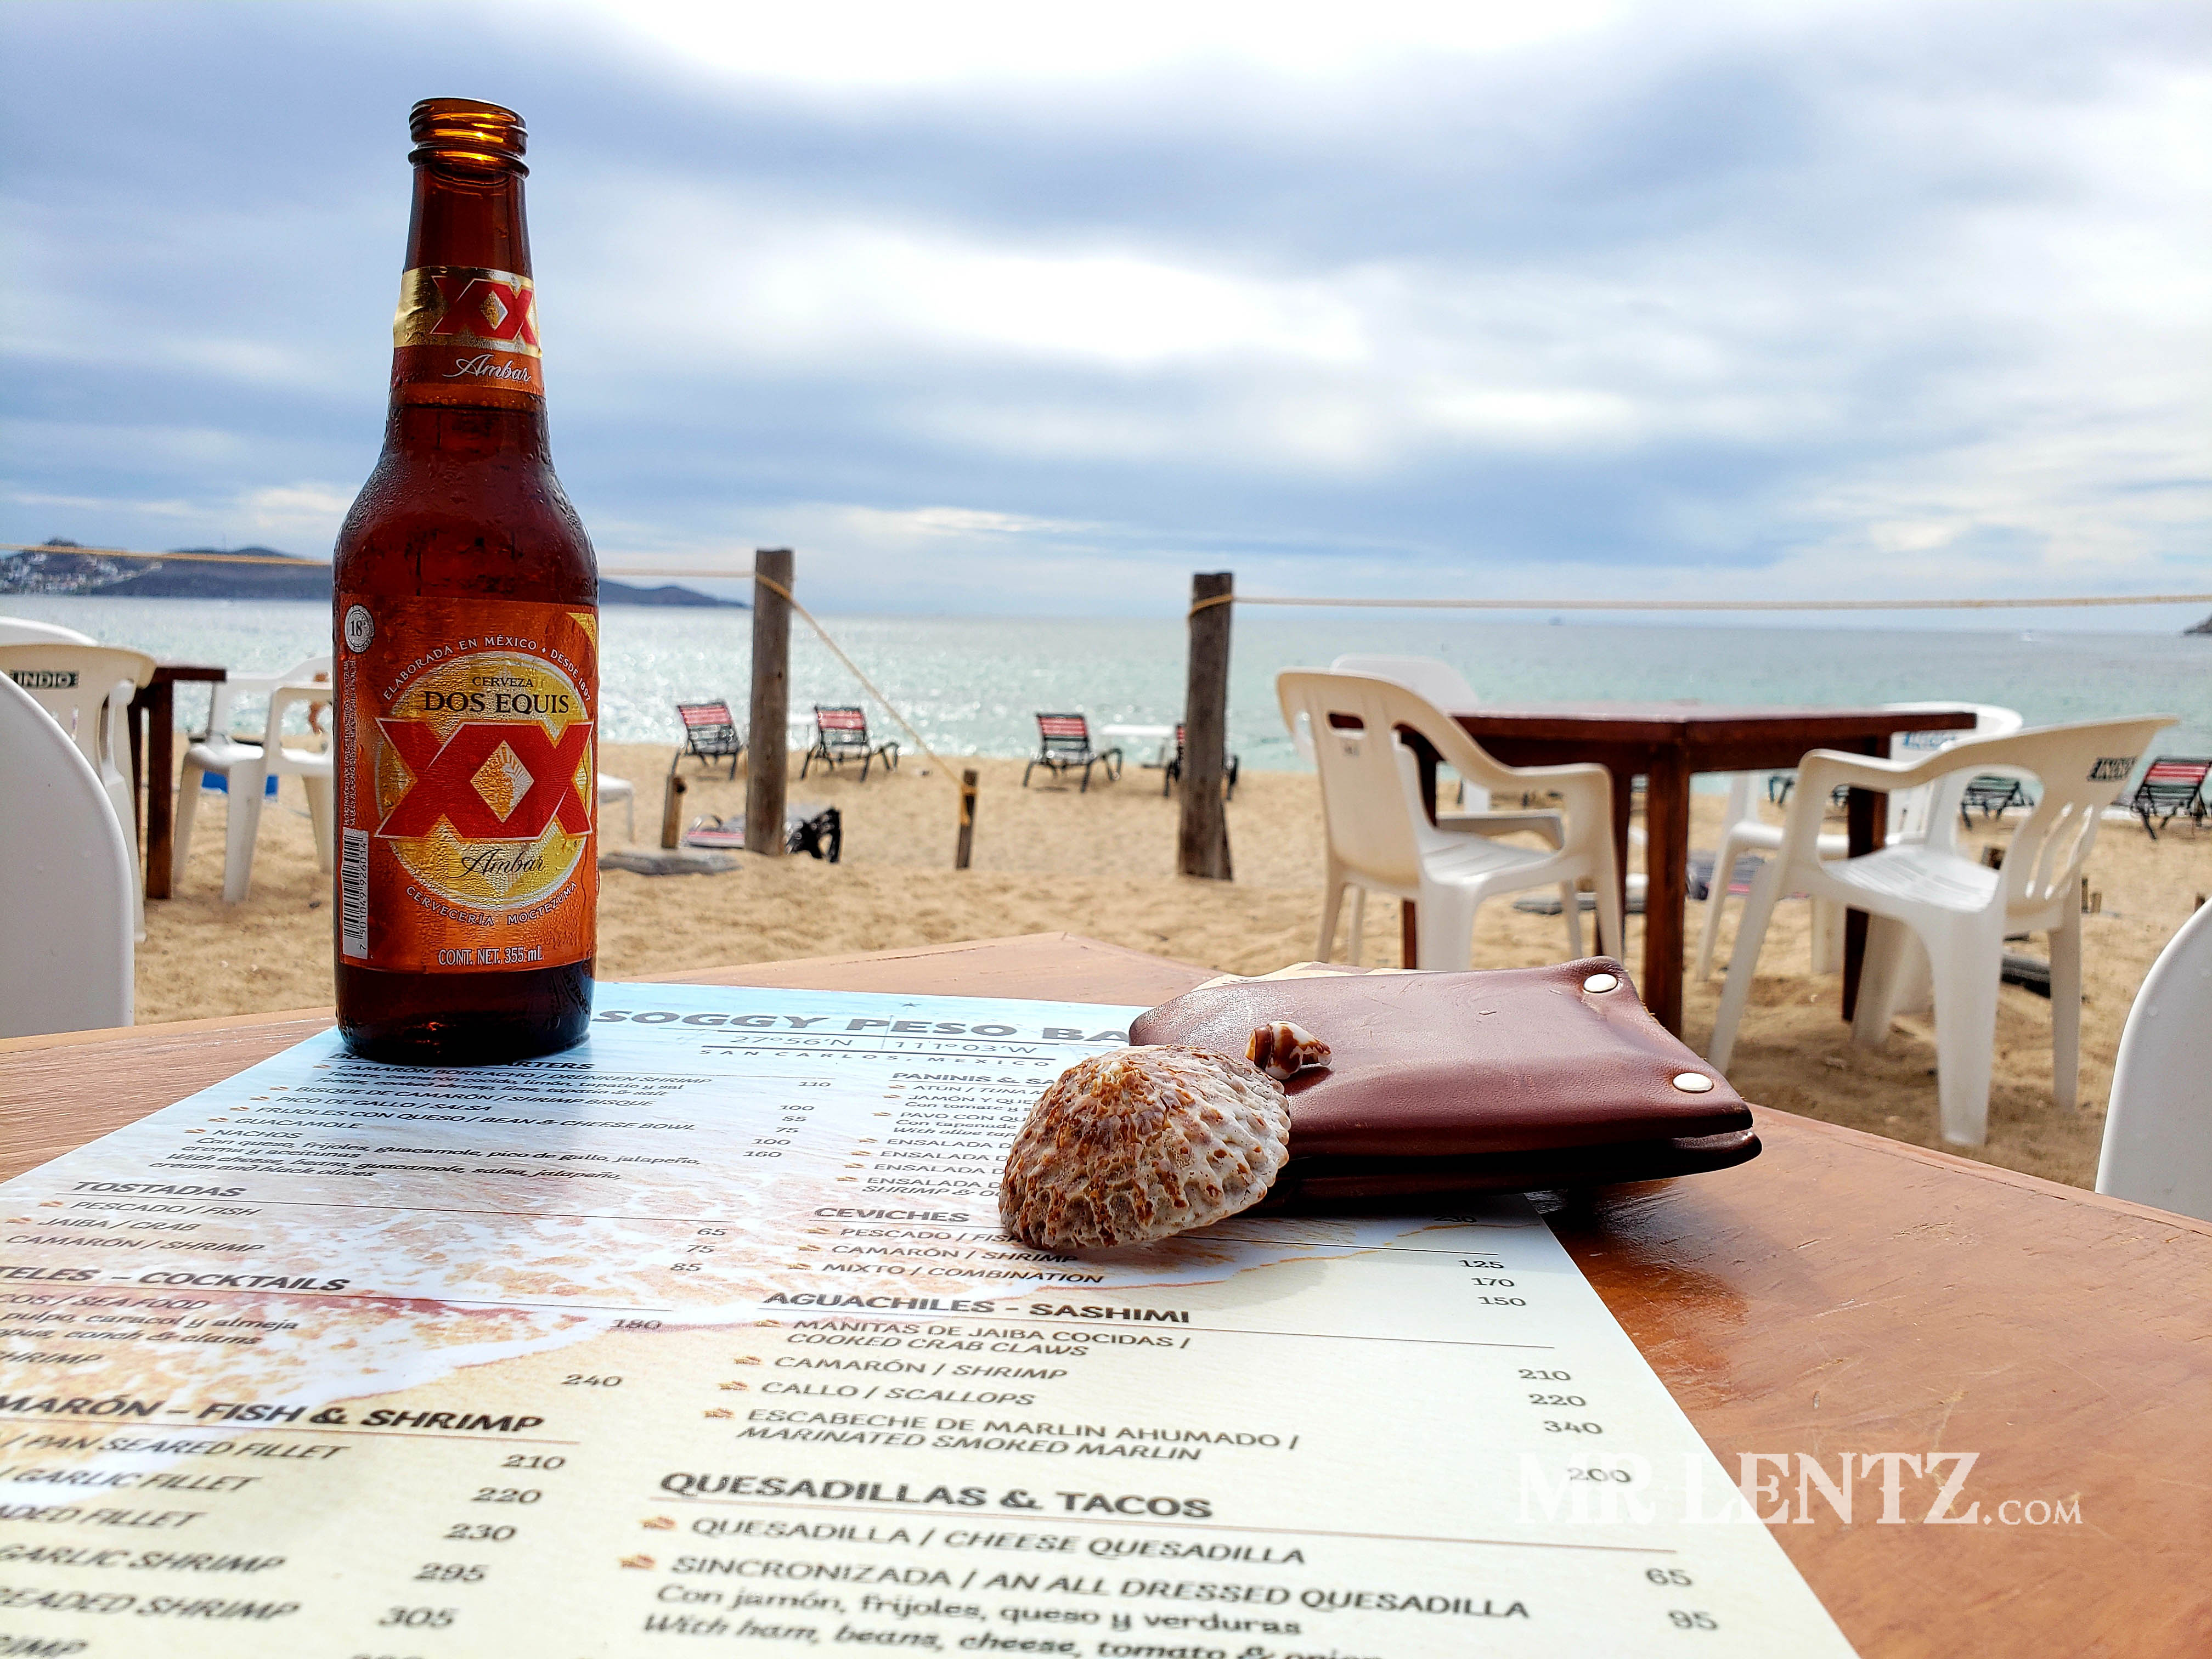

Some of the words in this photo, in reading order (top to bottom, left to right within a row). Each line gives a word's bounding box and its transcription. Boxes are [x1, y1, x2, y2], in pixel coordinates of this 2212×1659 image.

[443, 354, 531, 382] Ambar
[16, 671, 72, 688] INDIO
[384, 646, 453, 700] ELABORADA
[459, 639, 477, 651] EN
[485, 635, 537, 650] MÉXICO
[550, 649, 579, 678] DESDE
[578, 678, 591, 701] 1897
[472, 677, 534, 687] CERVEZA
[424, 691, 486, 712] DOS
[495, 693, 569, 714] EQUIS
[446, 849, 545, 879] Ambar
[407, 886, 494, 926] CERVECERÍA
[507, 882, 577, 926] MOCTEZUMA
[438, 949, 473, 966] CONT.
[476, 947, 501, 965] NET.
[504, 947, 524, 964] 355
[592, 1011, 830, 1028] SOGGY
[846, 1018, 1017, 1036] PESO
[775, 1052, 912, 1062] CARLOS,
[927, 1057, 1049, 1066] MEXICO
[337, 1065, 431, 1074] CAMARÓN
[433, 1069, 535, 1079] BORRACHO
[549, 1074, 640, 1082] DRUNKEN
[892, 1073, 991, 1082] PANINIS
[295, 1087, 366, 1095] BISQUE
[394, 1091, 492, 1100] CAMARÓN
[585, 1099, 658, 1107] BISQUE
[908, 1094, 976, 1103] JAMÓN
[913, 1084, 962, 1093] ATÚN
[256, 1107, 349, 1116] FRIJOLES
[349, 1111, 394, 1119] CON
[396, 1113, 468, 1123] QUESO
[480, 1116, 536, 1125] BEAN
[560, 1120, 636, 1128] CHEESE
[638, 1122, 698, 1131] BOWL
[353, 1099, 417, 1108] GALLO
[432, 1103, 493, 1111] SALSA
[900, 1111, 949, 1120] PAVO
[212, 1129, 303, 1139] NACHOS
[234, 1118, 364, 1129] GUACAMOLE
[196, 1137, 235, 1145] Con
[236, 1141, 295, 1149] queso,
[301, 1142, 371, 1153] frijoles,
[374, 1146, 482, 1158] guacamole,
[487, 1150, 531, 1159] pico
[560, 1153, 610, 1163] gallo,
[612, 1155, 701, 1165] jalapeño,
[886, 1138, 994, 1149] ENSALADA
[873, 1164, 986, 1175] ENSALADA
[72, 1181, 248, 1197] TOSTADAS
[70, 1201, 188, 1214] PESCADO
[199, 1206, 264, 1217] FISH
[697, 1228, 727, 1236] 65
[814, 1207, 970, 1222] CEVICHES
[38, 1217, 109, 1229] JAIBA
[129, 1221, 202, 1232] CRAB
[686, 1244, 716, 1254] 75
[840, 1228, 952, 1241] PESCADO
[1458, 1260, 1505, 1269] 125
[6, 1234, 143, 1249] CAMARÓN
[159, 1240, 267, 1252] SHRIMP
[670, 1263, 704, 1272] 85
[831, 1245, 960, 1259] CAMARÓN
[981, 1251, 1079, 1263] SHRIMP
[1471, 1277, 1515, 1287] 170
[138, 1271, 352, 1290] COCKTAILS
[823, 1263, 907, 1275] MIXTO
[927, 1267, 1103, 1283] COMBINATION
[1477, 1296, 1527, 1307] 150
[132, 1298, 212, 1311] FOOD
[612, 1318, 663, 1330] 180
[764, 1292, 995, 1313] AGUACHILES
[1029, 1303, 1190, 1323] SASHIMI
[787, 1333, 901, 1347] COOKED
[907, 1338, 983, 1352] CRAB
[990, 1341, 1090, 1356] CLAWS
[793, 1320, 920, 1335] MANITAS
[927, 1324, 962, 1337] DE
[967, 1326, 1044, 1340] JAIBA
[1052, 1330, 1174, 1347] COCIDAS
[1518, 1367, 1572, 1382] 210
[561, 1373, 624, 1388] 240
[774, 1356, 926, 1374] CAMARÓN
[952, 1363, 1068, 1380] SHRIMP
[1528, 1392, 1588, 1408] 220
[196, 1402, 308, 1423] FISH
[361, 1408, 545, 1433] SHRIMP
[761, 1381, 860, 1397] CALLO
[883, 1386, 1036, 1406] SCALLOPS
[1543, 1419, 1605, 1435] 340
[747, 1408, 929, 1429] ESCABECHE
[935, 1417, 976, 1431] DE
[982, 1419, 1106, 1438] MARLIN
[1115, 1426, 1280, 1447] AHUMADO
[97, 1436, 236, 1455] SEARED
[232, 1442, 352, 1460] FILLET
[500, 1453, 567, 1470] 210
[735, 1426, 927, 1447] MARINATED
[931, 1434, 1070, 1454] SMOKED
[1074, 1442, 1202, 1461] MARLIN
[1567, 1466, 1632, 1485] 200
[11, 1468, 142, 1487] GARLIC
[137, 1472, 263, 1492] FILLET
[471, 1486, 544, 1504] 220
[660, 1471, 987, 1508] QUESADILLAS
[1056, 1489, 1214, 1519] TACOS
[442, 1522, 517, 1542] 230
[128, 1550, 288, 1573] SHRIMP
[413, 1562, 491, 1583] 295
[691, 1516, 911, 1546] QUESADILLA
[943, 1530, 1081, 1555] CHEESE
[1087, 1537, 1306, 1565] QUESADILLA
[1645, 1567, 1694, 1589] 65
[670, 1555, 952, 1586] SINCRONIZADA
[983, 1573, 1040, 1590] AN
[1046, 1574, 1111, 1596] ALL
[1119, 1578, 1291, 1605] DRESSED
[1300, 1588, 1530, 1619] QUESADILLA
[1668, 1609, 1720, 1632] 95
[377, 1606, 460, 1629] 305
[656, 1583, 724, 1604] Con
[726, 1585, 846, 1615] jamón,
[860, 1593, 988, 1622] frijoles,
[998, 1604, 1101, 1626] queso
[1110, 1611, 1133, 1632] y
[1143, 1612, 1303, 1636] verduras
